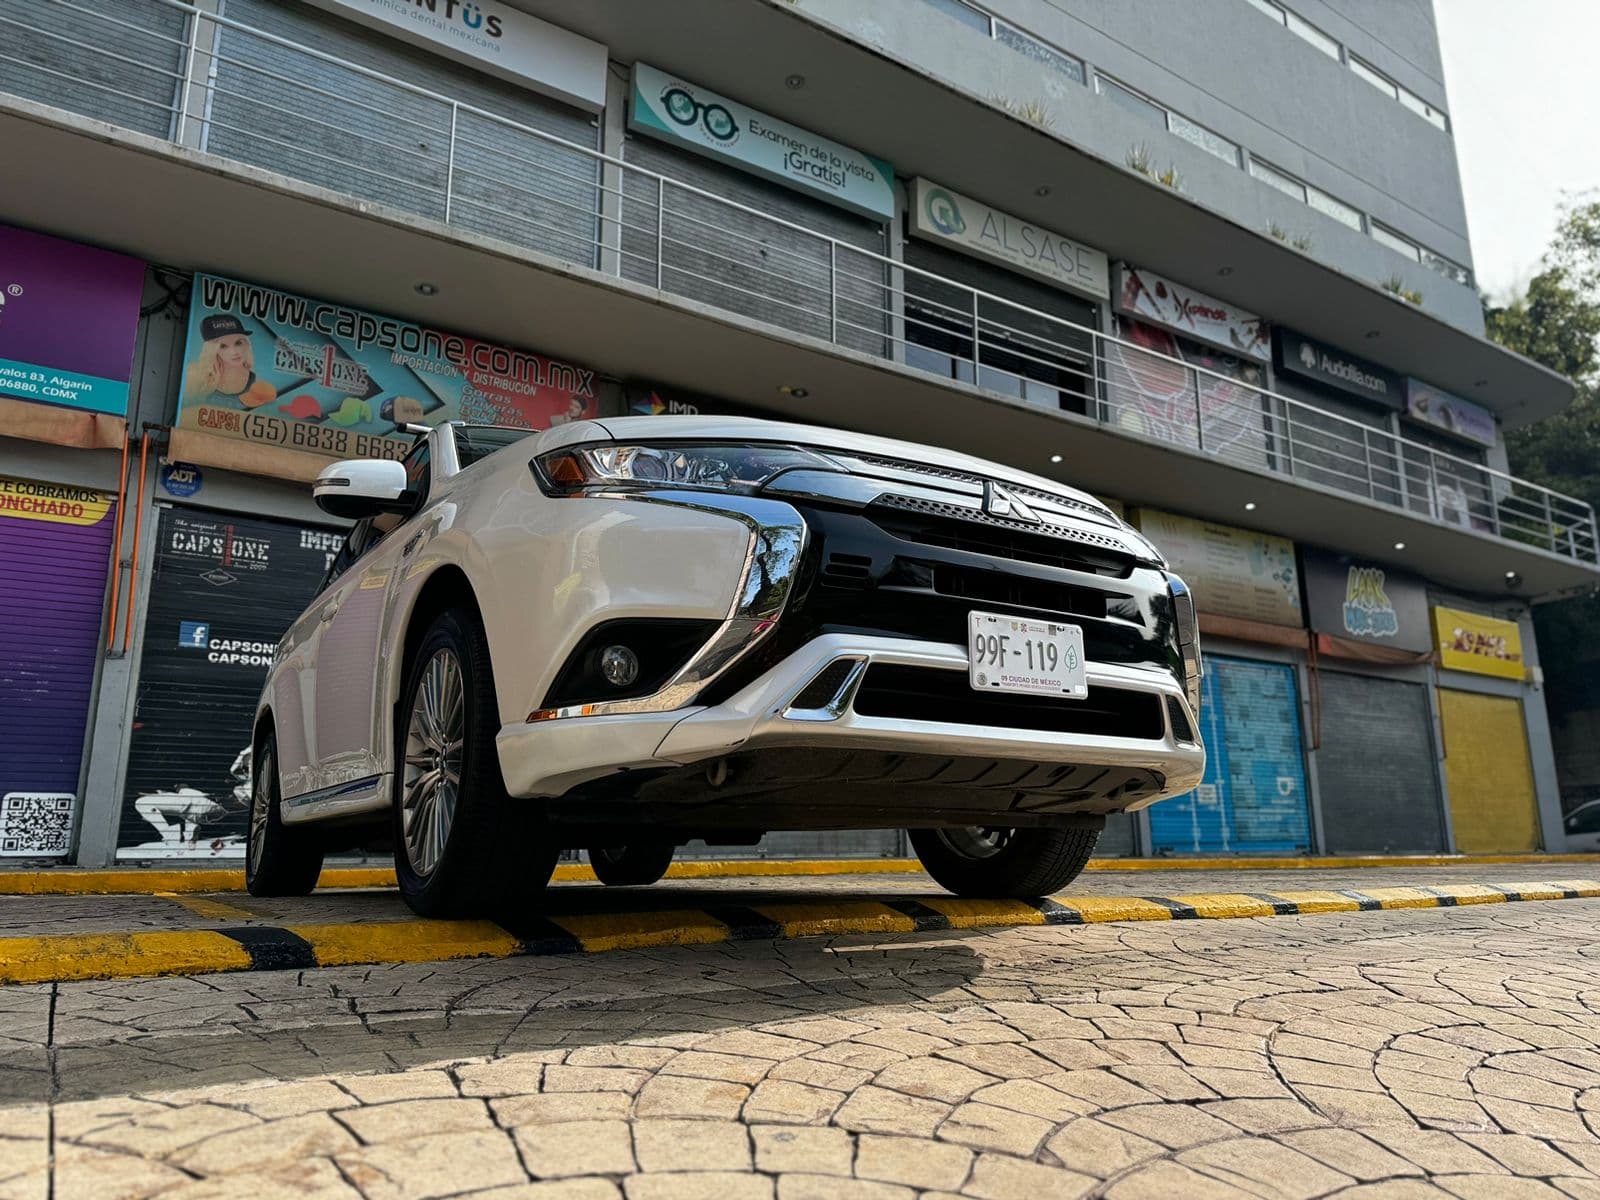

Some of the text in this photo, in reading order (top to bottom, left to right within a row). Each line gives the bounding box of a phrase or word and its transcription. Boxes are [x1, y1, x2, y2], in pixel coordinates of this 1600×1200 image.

[406, 0, 502, 38] NTÜS
[410, 9, 446, 30] dental
[449, 25, 500, 52] mexicana
[749, 119, 808, 155] Examen
[809, 146, 828, 162] de
[829, 152, 841, 168] la
[843, 160, 875, 182] vista
[784, 151, 846, 188] ¡Gratis!
[980, 211, 1094, 281] ALSASE
[203, 277, 594, 398] www.capsone.com.mx
[0, 378, 78, 400] 06880, CDMX
[29, 372, 47, 383] 83,
[243, 414, 287, 444] (55)
[293, 423, 348, 453] 6838
[356, 435, 408, 460] 6683
[16, 482, 98, 503] COBRAMOS
[168, 469, 197, 484] ADT
[300, 530, 347, 552] IMPO
[208, 652, 273, 667] CAPSON
[975, 633, 1059, 673] 99F-119
[1008, 675, 1030, 684] CIUDAD
[1030, 677, 1039, 685] DE
